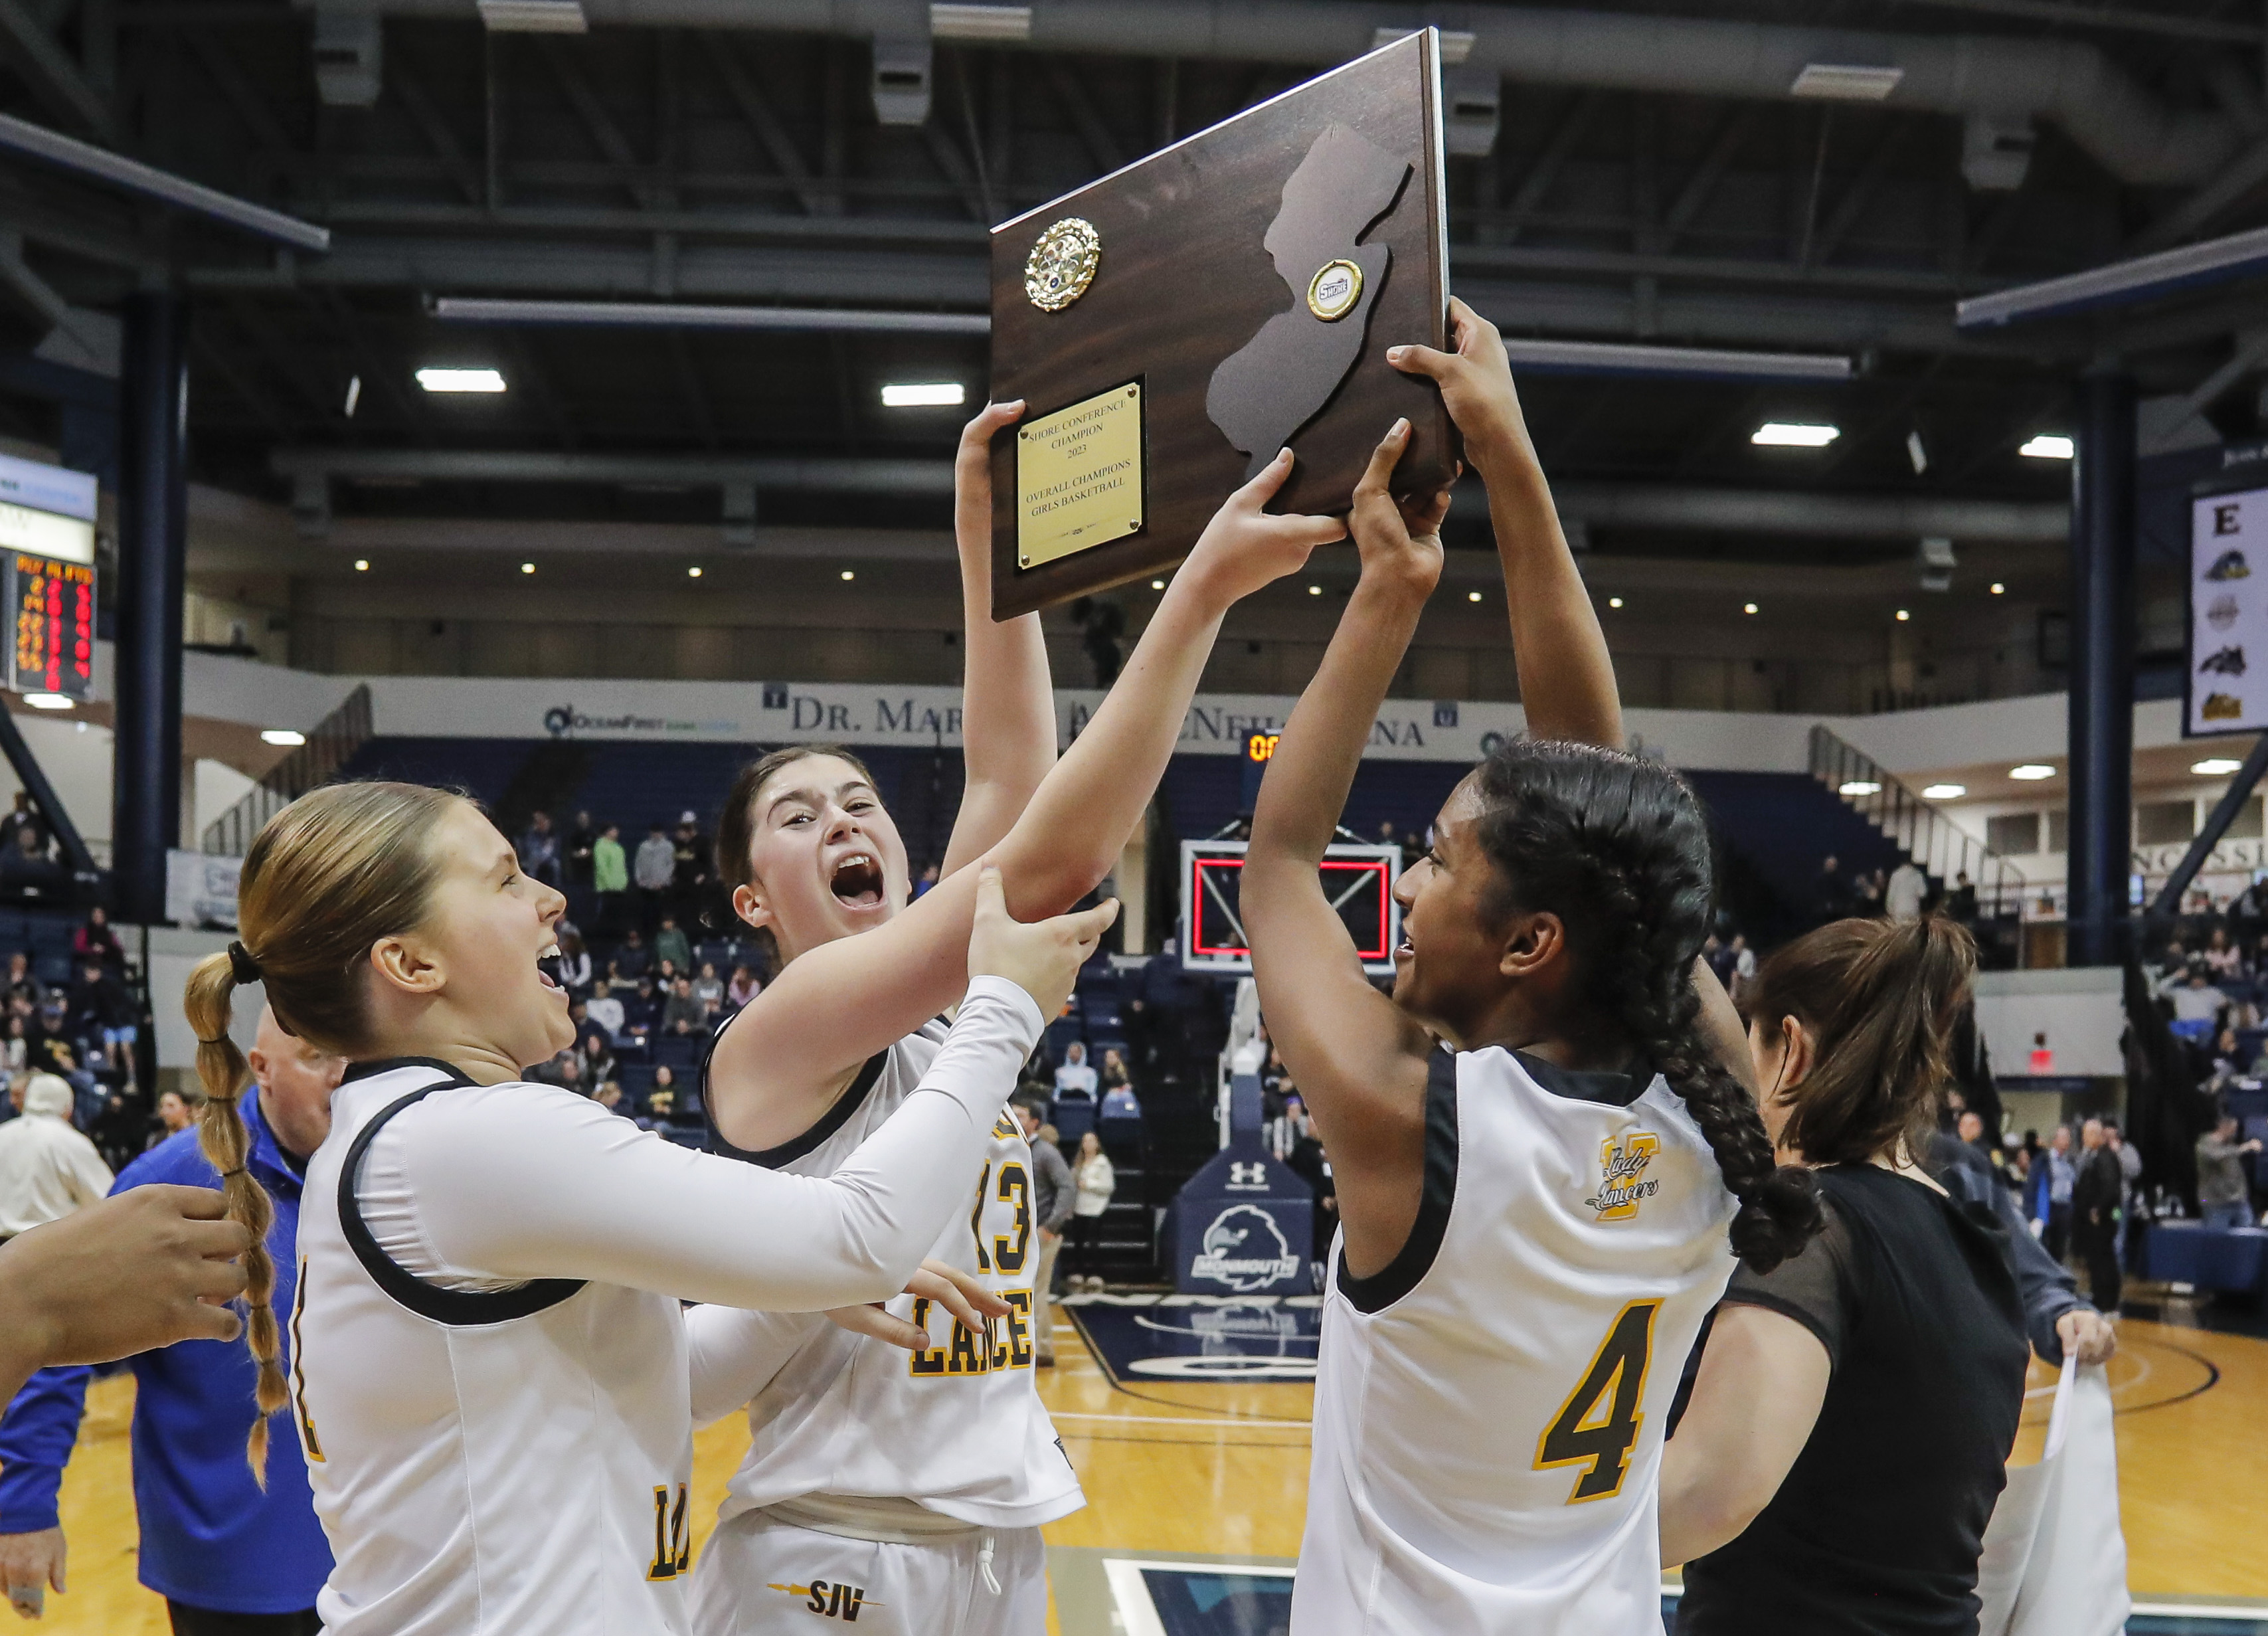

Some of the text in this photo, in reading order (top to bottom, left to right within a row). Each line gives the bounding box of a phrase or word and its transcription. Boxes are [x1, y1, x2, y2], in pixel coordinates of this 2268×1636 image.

[1029, 399, 1126, 444] SHORE CONFERENCE
[1051, 422, 1104, 450] CHAMPION
[1067, 444, 1087, 459] 2023
[1026, 458, 1131, 504] OVERALL CHAMPIONS
[1031, 477, 1125, 517] GIRLS BASKETBALL
[2214, 503, 2241, 537] E
[1603, 1147, 1651, 1180] Lady
[1585, 1179, 1659, 1212] Lancers
[971, 1158, 1032, 1275] 13
[909, 1287, 1033, 1378] LANCE
[1531, 1297, 1666, 1505] 4
[806, 1580, 865, 1622] SJV
